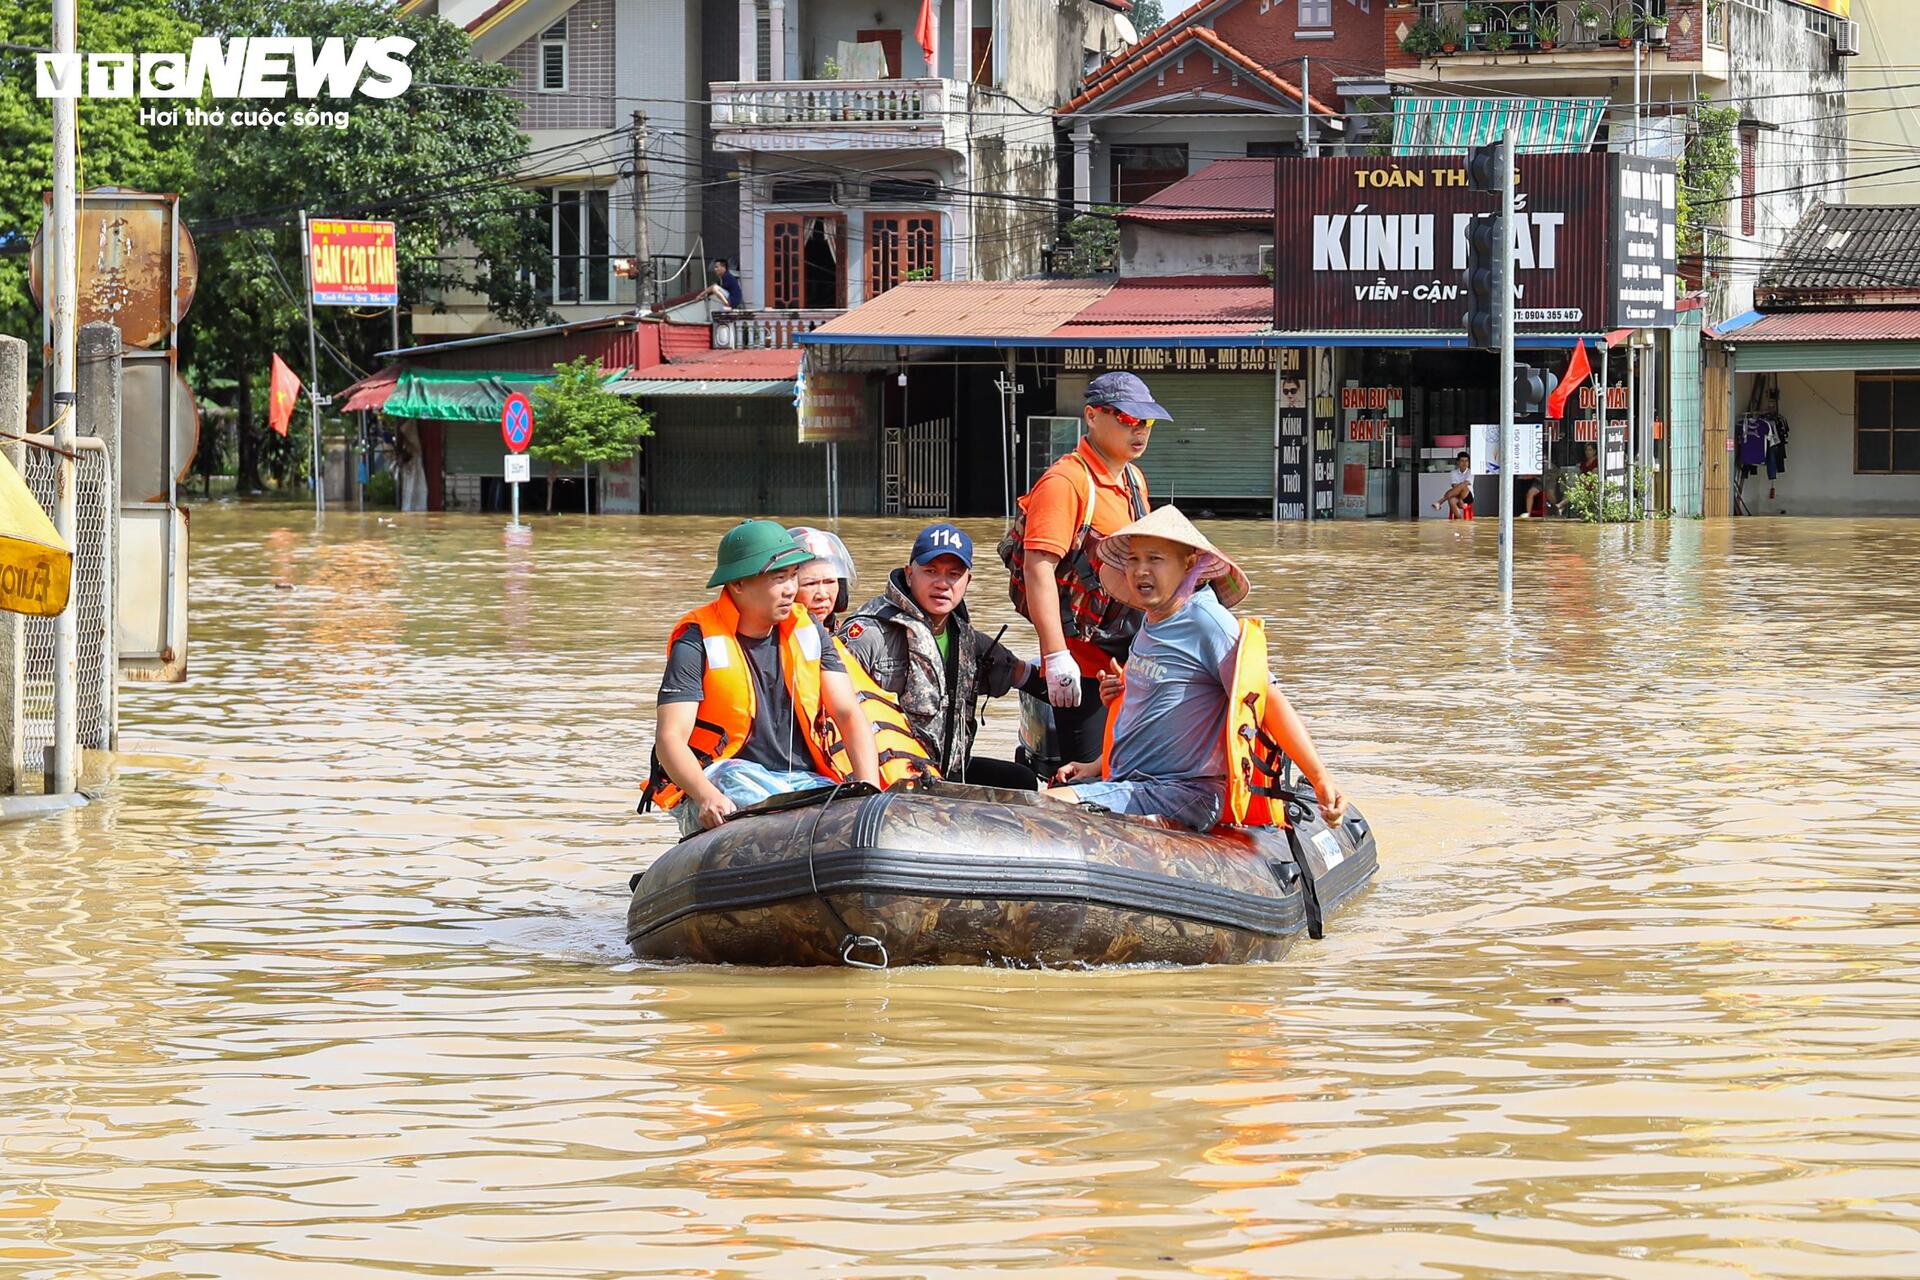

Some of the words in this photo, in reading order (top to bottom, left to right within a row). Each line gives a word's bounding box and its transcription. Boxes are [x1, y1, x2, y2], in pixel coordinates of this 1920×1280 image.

[1354, 164, 1424, 188] TOÀN
[1313, 204, 1434, 271] KÍNH
[313, 236, 342, 284] CÂN
[343, 246, 368, 285] 120
[367, 234, 395, 285] TẤN
[1354, 277, 1399, 301] VIỄN
[1413, 280, 1458, 303] CẬN
[1525, 311, 1545, 320] 0904
[1564, 311, 1579, 319] 467
[1190, 349, 1207, 370] DA
[1282, 413, 1302, 436] KÍNH
[1283, 439, 1301, 465] MẮT
[1283, 469, 1301, 493] THỜI
[1279, 502, 1305, 520] TRANG
[930, 529, 963, 549] 114
